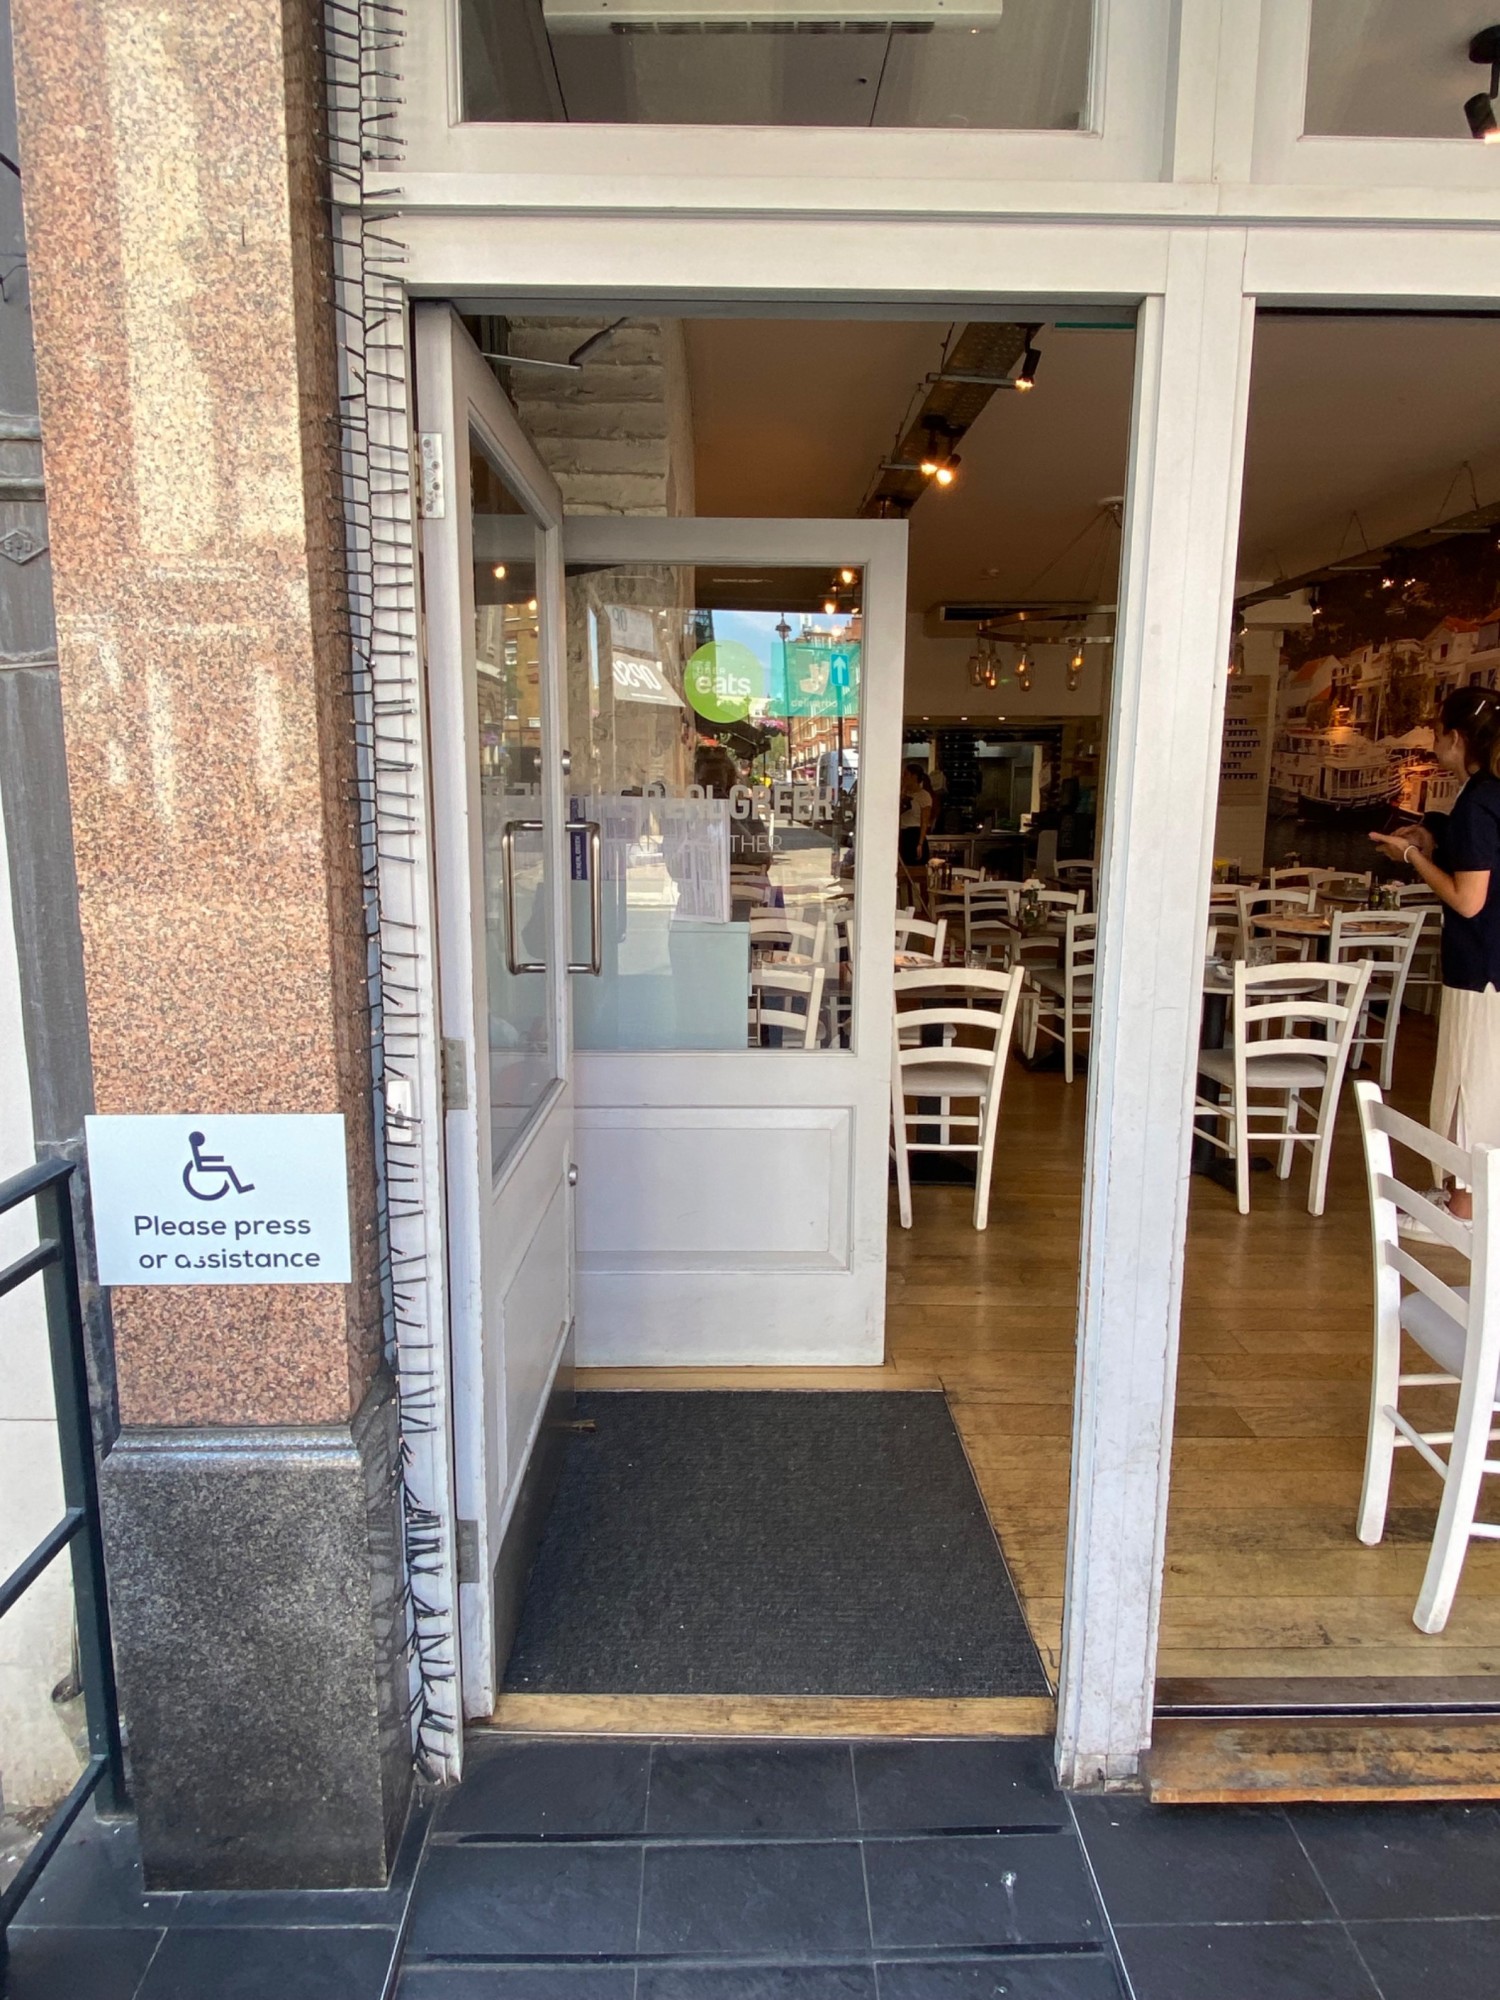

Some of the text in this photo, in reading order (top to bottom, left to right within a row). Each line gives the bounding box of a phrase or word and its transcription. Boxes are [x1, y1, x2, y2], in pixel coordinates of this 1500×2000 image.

[695, 673, 751, 695] eats
[729, 784, 833, 820] GREEK
[134, 1215, 312, 1241] Please press
[138, 1248, 321, 1269] or assistance
